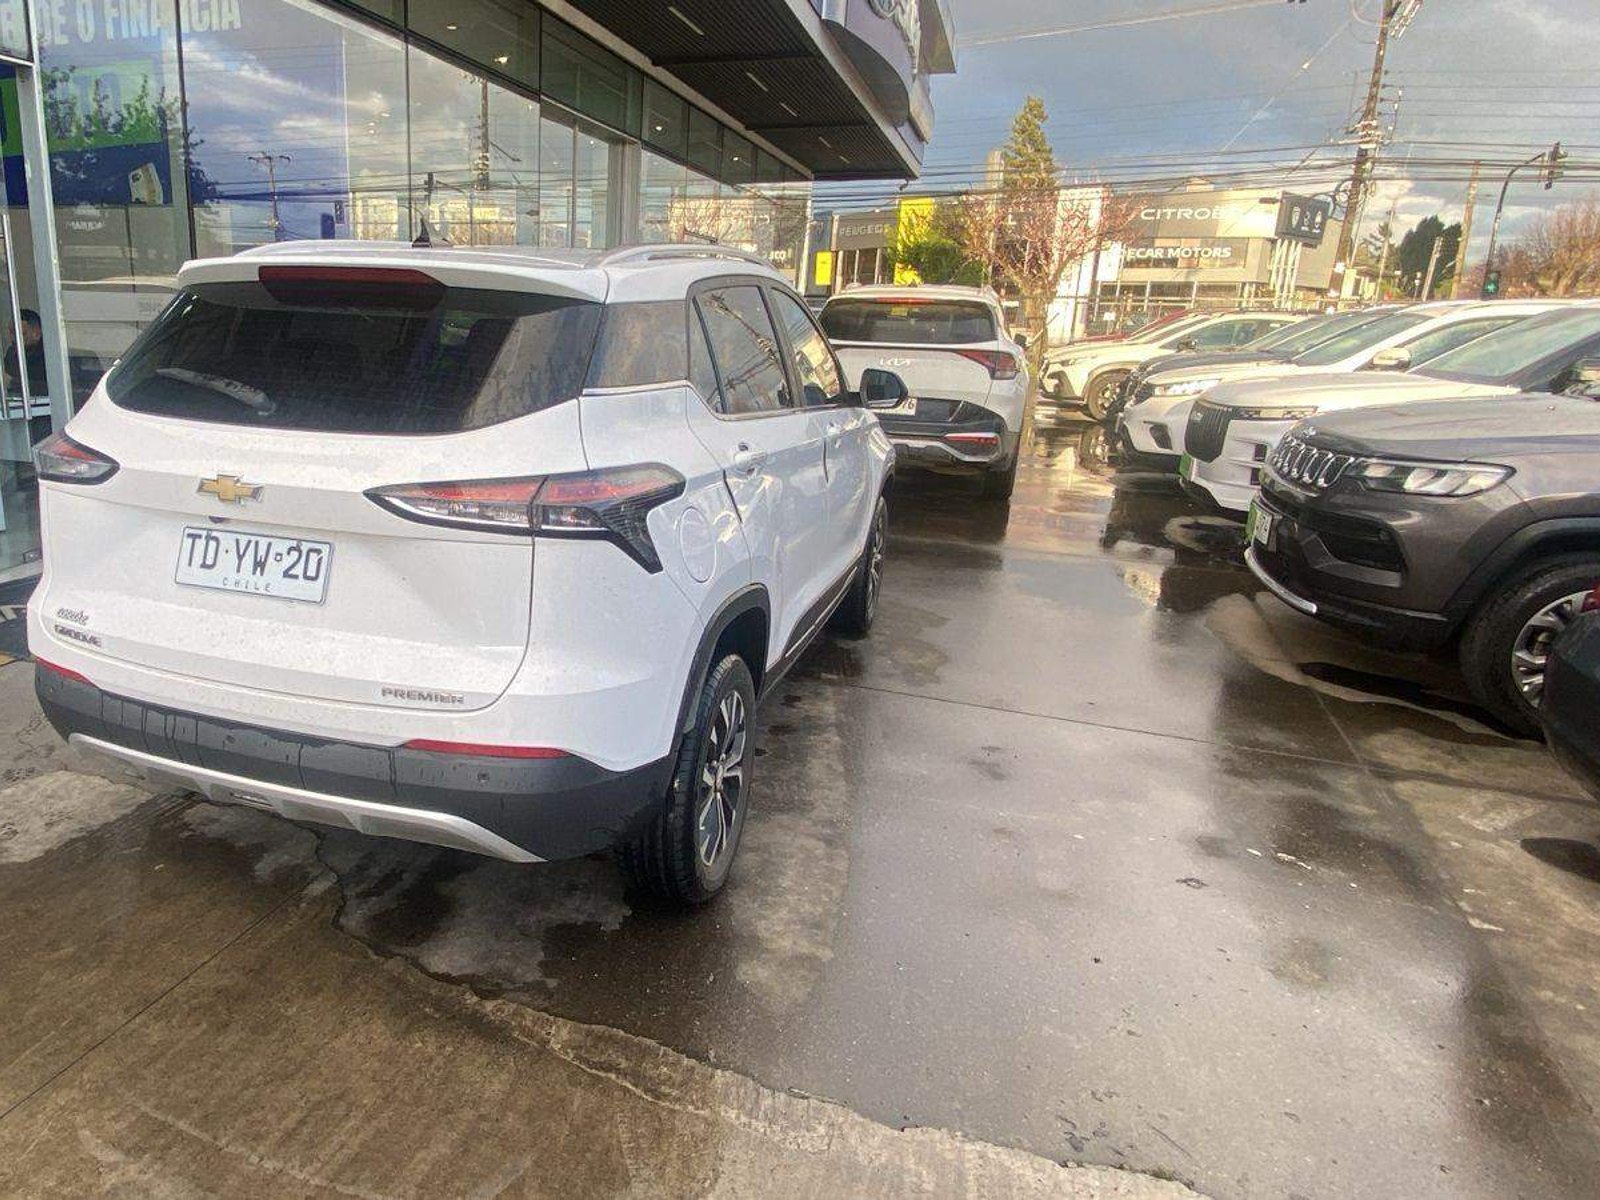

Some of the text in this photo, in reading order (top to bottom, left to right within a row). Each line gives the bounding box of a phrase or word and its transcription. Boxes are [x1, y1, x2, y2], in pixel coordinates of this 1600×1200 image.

[839, 223, 885, 237] PEUGEO
[1167, 247, 1232, 258] MOTORS
[222, 577, 273, 592] CHILE
[381, 686, 465, 705] PREMIER
